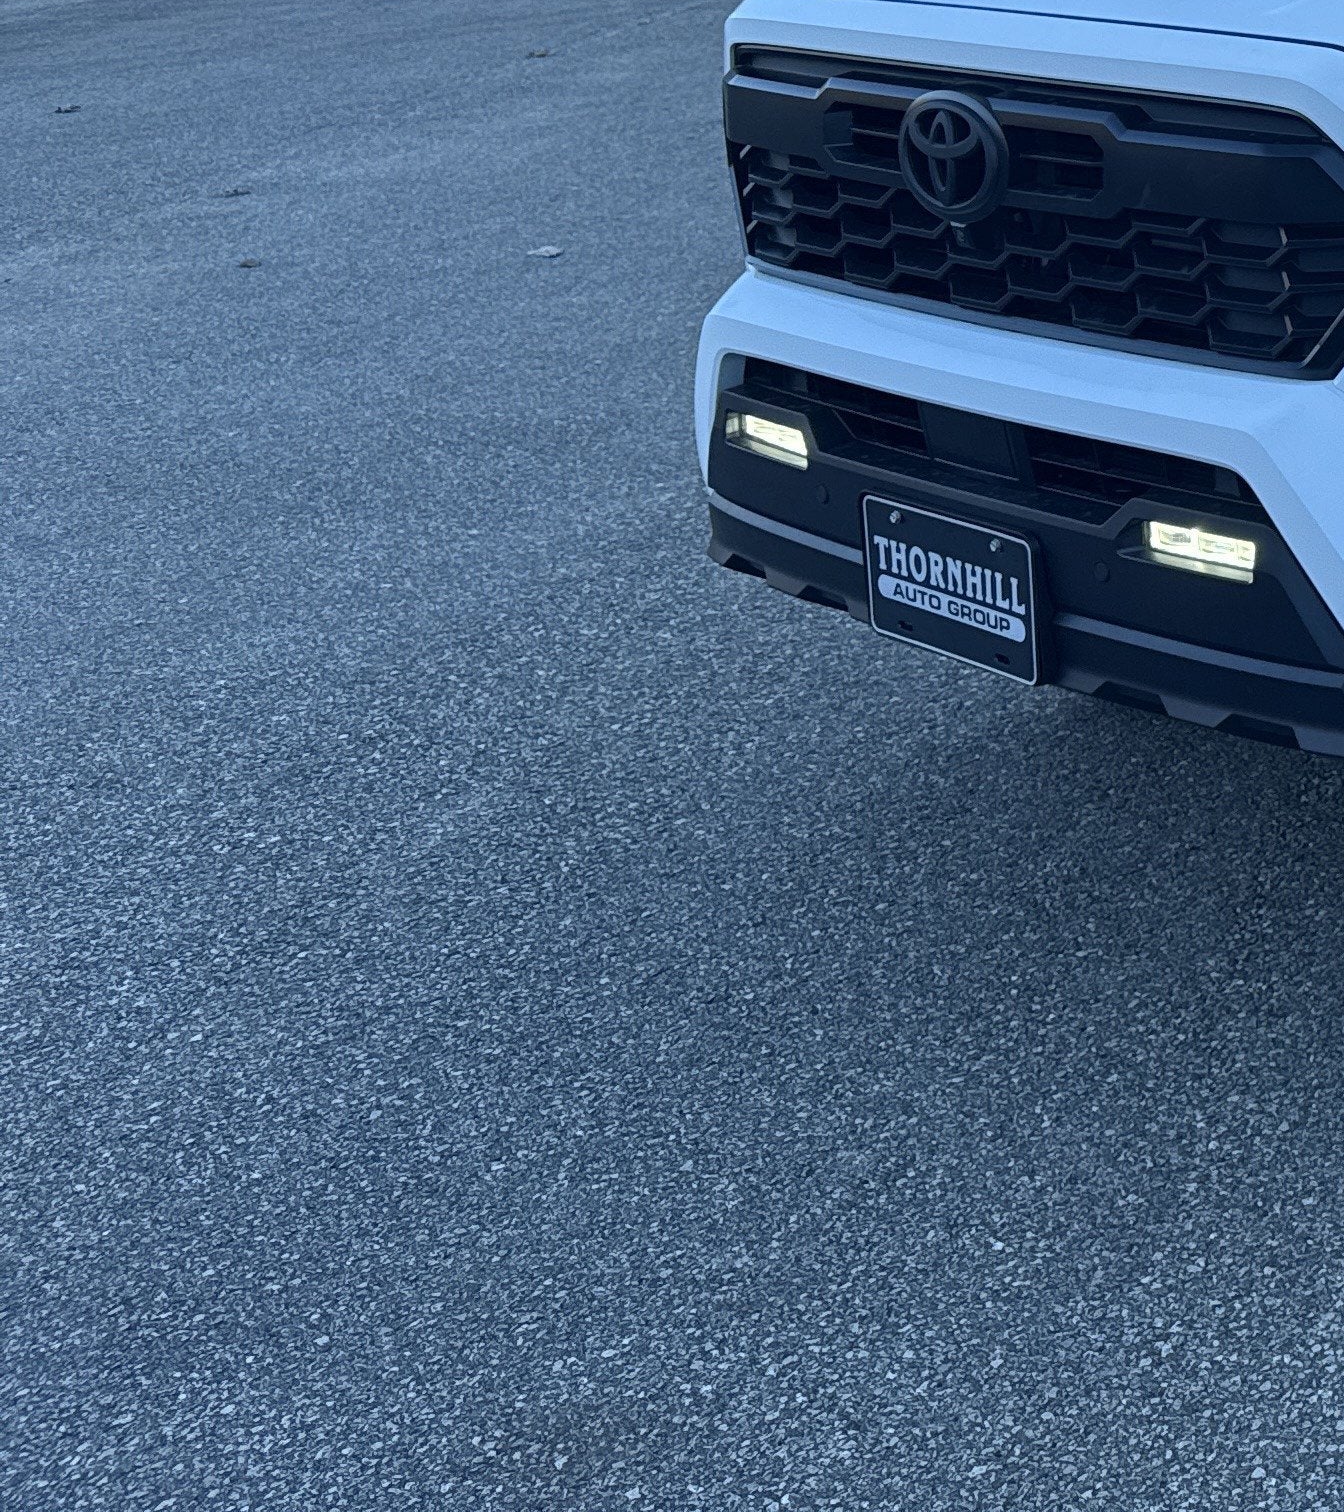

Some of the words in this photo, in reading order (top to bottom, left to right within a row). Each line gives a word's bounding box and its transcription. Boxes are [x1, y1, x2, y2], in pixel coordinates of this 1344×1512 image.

[873, 534, 1026, 615] THORNHILL
[893, 582, 941, 610] AUTO
[947, 600, 1011, 633] GROUP
